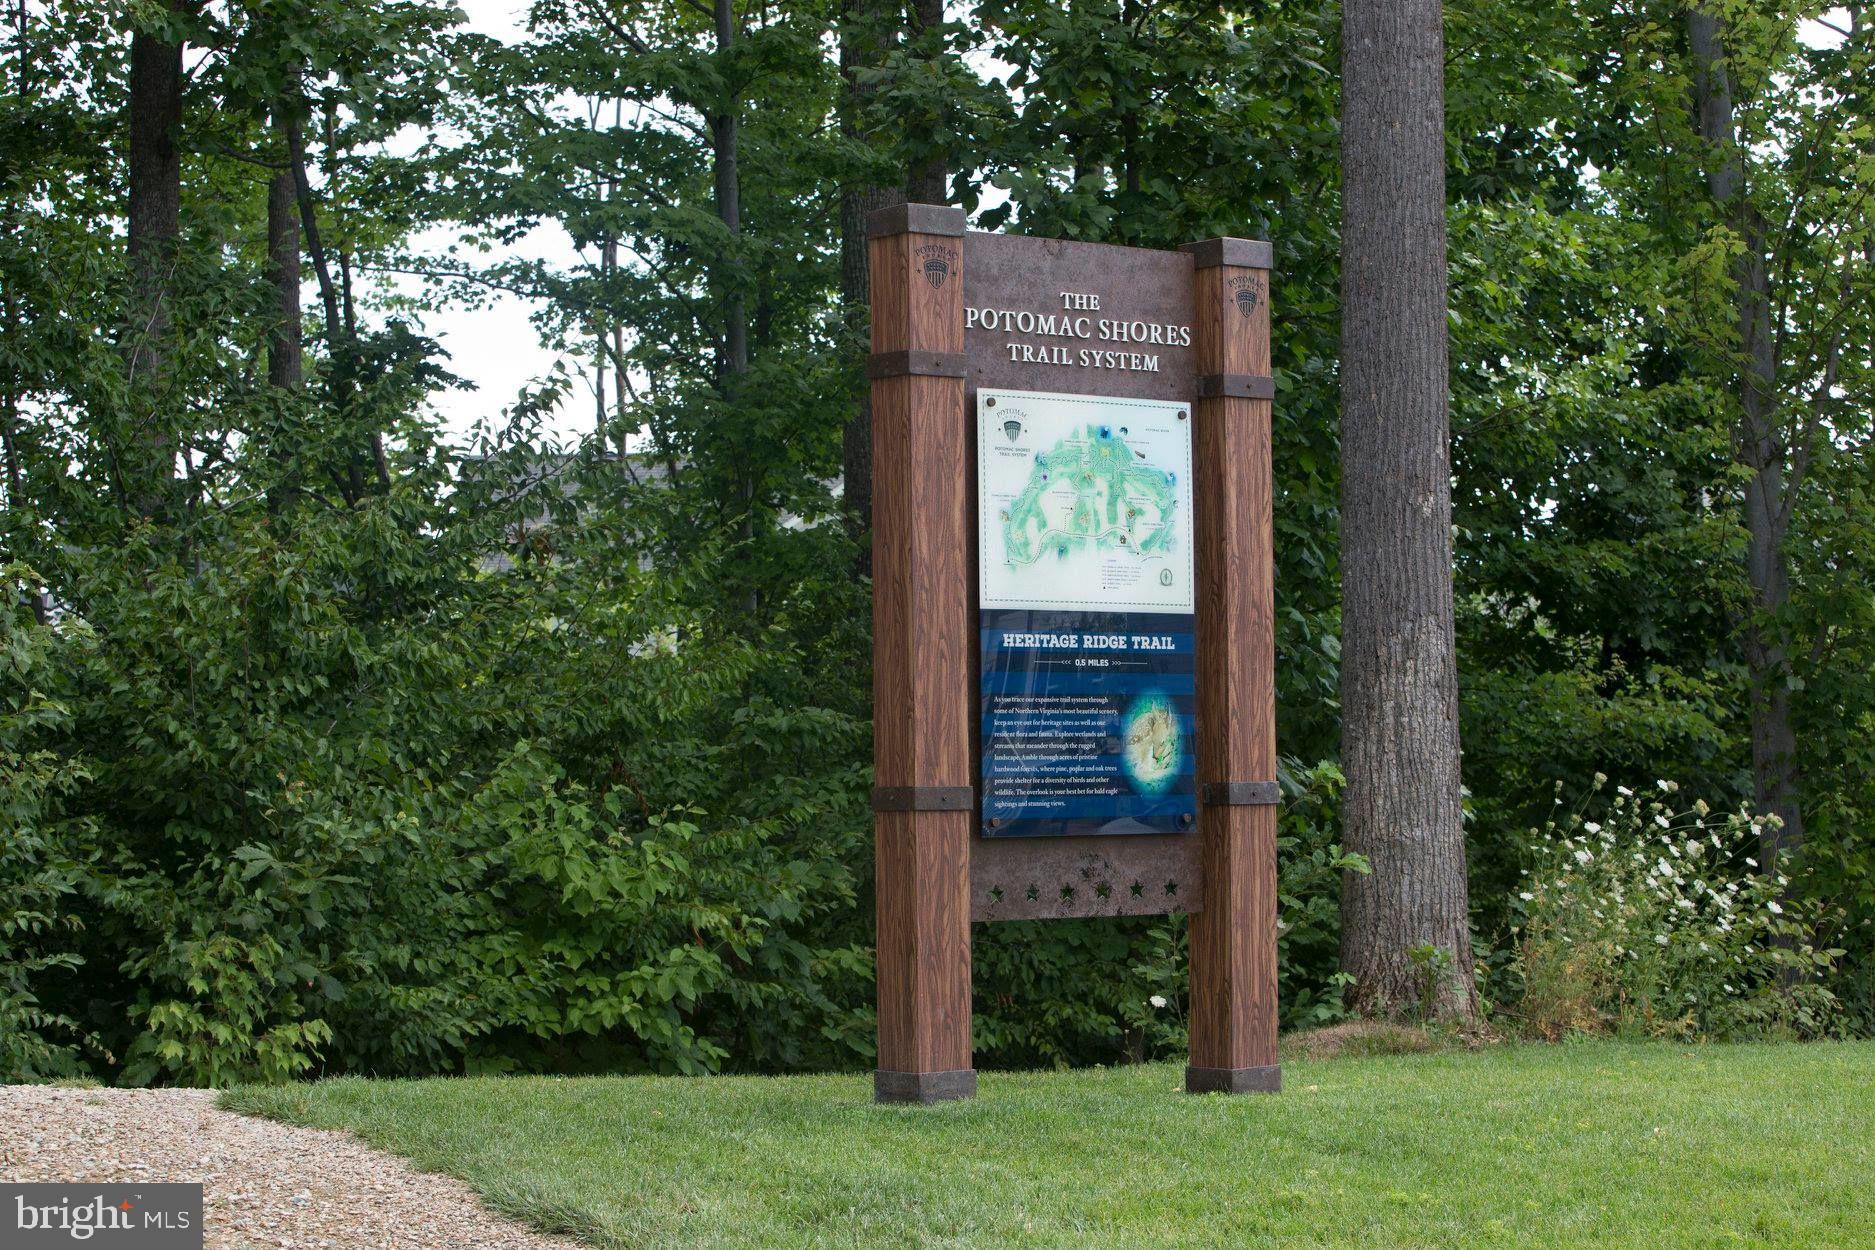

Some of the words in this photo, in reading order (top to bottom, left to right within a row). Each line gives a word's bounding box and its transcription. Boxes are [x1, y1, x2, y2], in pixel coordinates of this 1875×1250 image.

[916, 245, 959, 258] POTOMAC
[1228, 276, 1265, 291] POTOMAC
[1060, 292, 1100, 311] THE
[965, 307, 1091, 340] POTOMAC
[1098, 320, 1191, 347] SHORES
[1007, 343, 1073, 366] TRAIL
[1079, 349, 1159, 372] SYSTEM
[1003, 633, 1078, 648] HERITAGE
[1083, 635, 1127, 649] RIDGE
[1132, 636, 1175, 650] TRAIL
[1075, 658, 1086, 667] 0.5
[1087, 659, 1109, 667] MILES
[1035, 696, 1059, 704] expansive
[1071, 696, 1088, 704] system
[1088, 696, 1108, 704] through
[994, 719, 1006, 727] keep
[1041, 719, 1062, 727] heritage
[1055, 731, 1073, 739] Explore
[1049, 742, 1069, 750] through
[1078, 742, 1095, 750] rugged
[1039, 754, 1059, 762] through
[1079, 754, 1097, 762] pristine
[1056, 766, 1068, 774] pine,
[1069, 766, 1085, 774] poplar
[995, 777, 1014, 785] provide
[1045, 777, 1066, 785] diversity
[995, 800, 1018, 808] sightings
[1028, 800, 1050, 808] stunning
